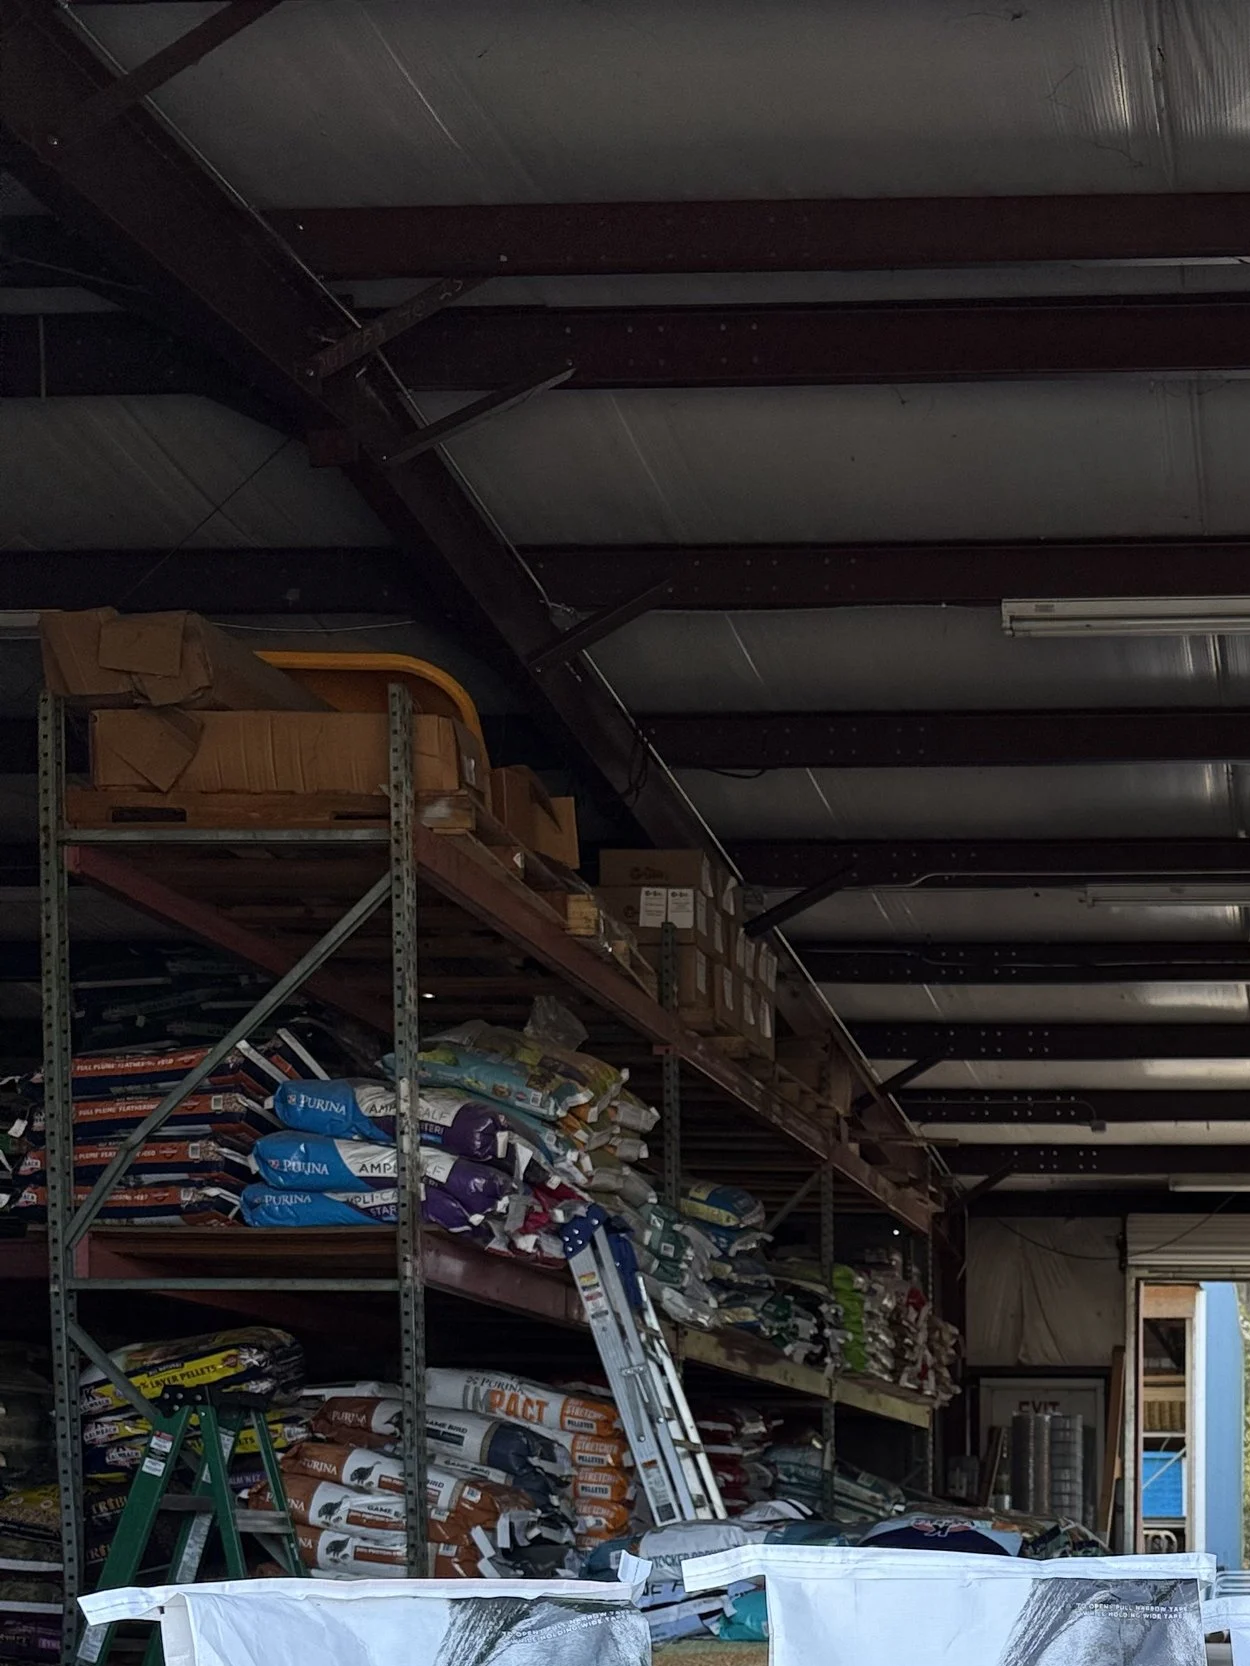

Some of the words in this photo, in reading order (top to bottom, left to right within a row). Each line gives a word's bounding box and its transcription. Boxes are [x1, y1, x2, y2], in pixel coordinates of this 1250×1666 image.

[300, 1095, 347, 1116] PURINA
[283, 1160, 329, 1175] PURINA
[264, 1193, 312, 1205] PURINA
[150, 1374, 179, 1389] LAYER
[180, 1364, 218, 1384] PELLETS
[567, 1418, 595, 1430] PELLETED
